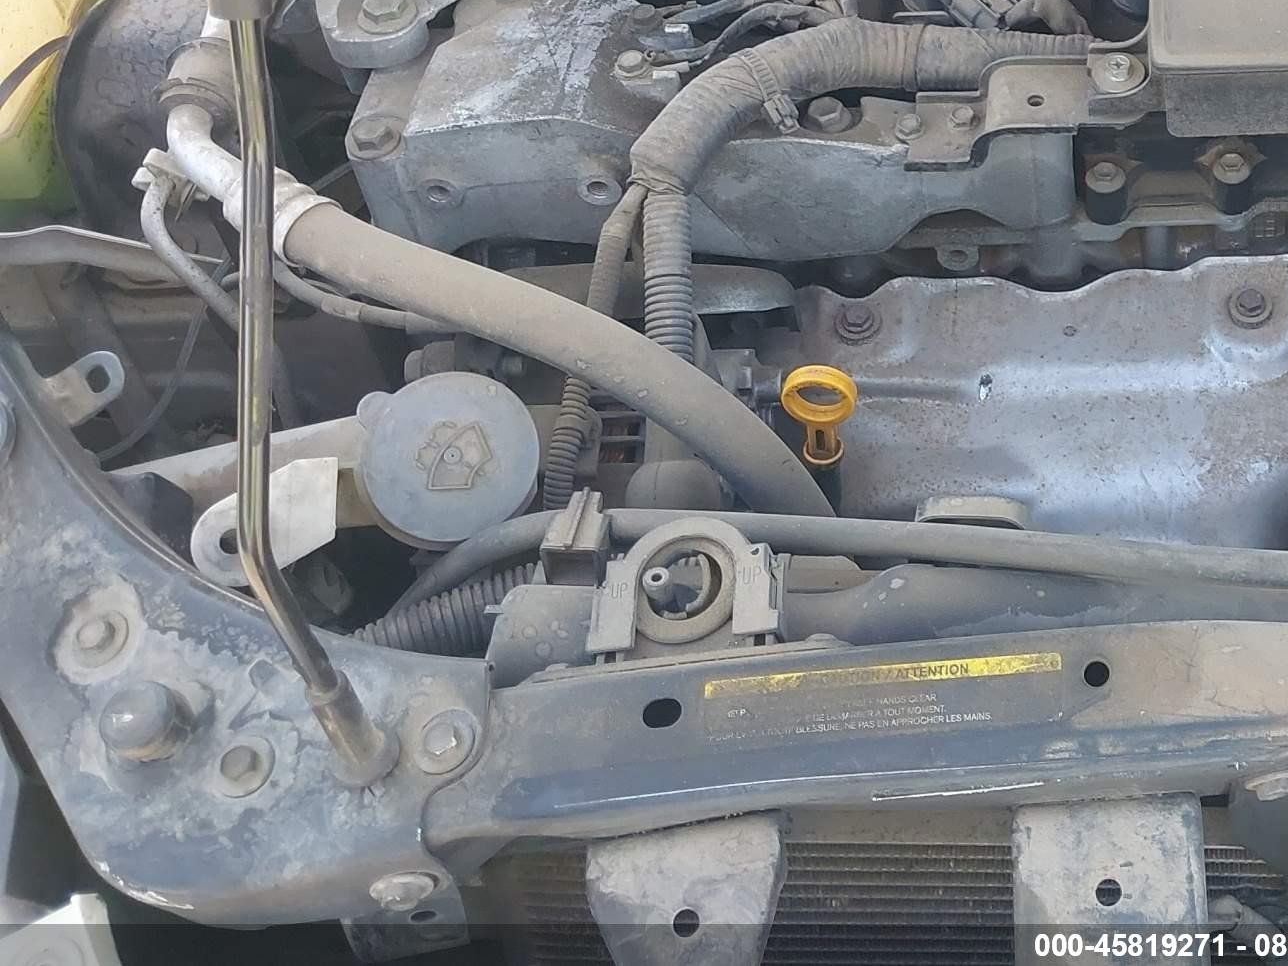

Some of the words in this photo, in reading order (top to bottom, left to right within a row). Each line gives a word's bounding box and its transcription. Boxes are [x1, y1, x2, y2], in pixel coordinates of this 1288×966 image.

[743, 564, 764, 586] UP
[610, 582, 629, 600] UP
[895, 663, 969, 681] ATTENTION
[858, 719, 876, 729] PAS
[891, 715, 944, 727] APPROCHER
[945, 713, 962, 723] LES
[963, 711, 993, 722] MAINS.
